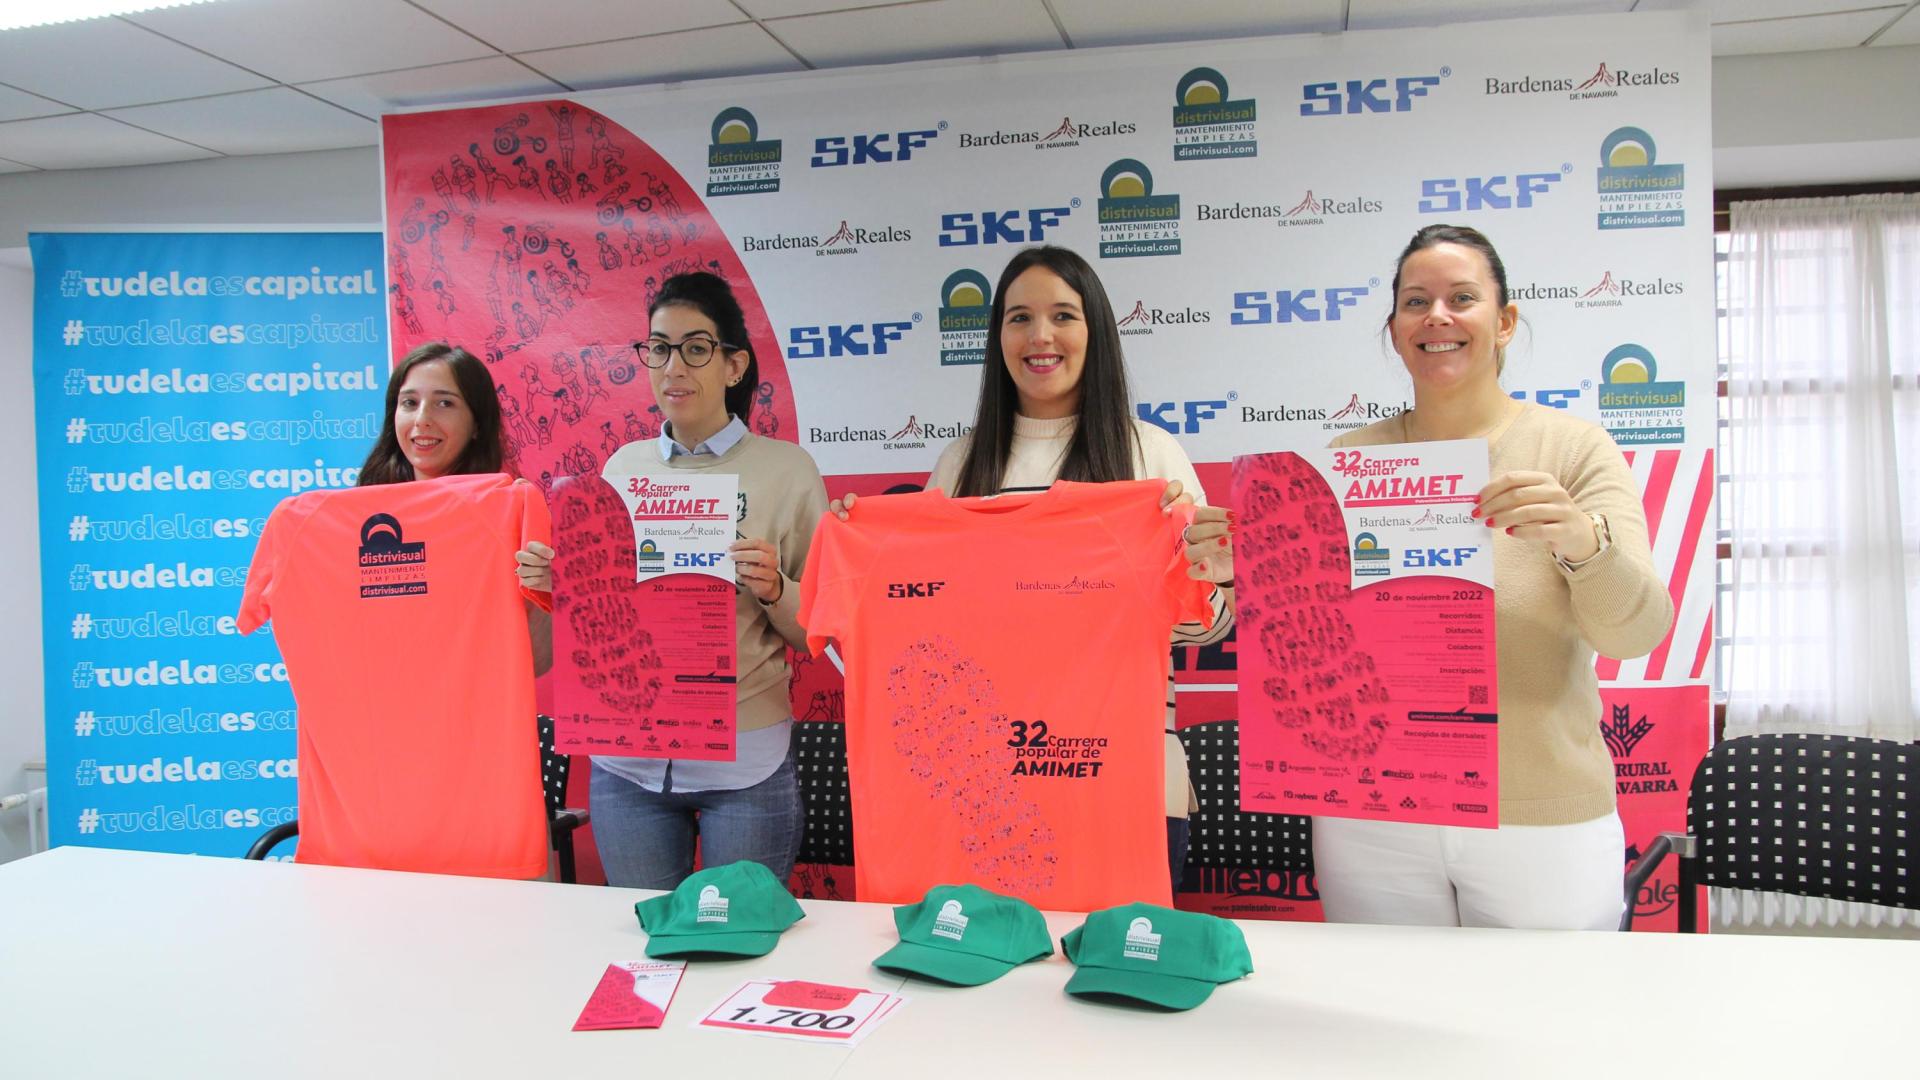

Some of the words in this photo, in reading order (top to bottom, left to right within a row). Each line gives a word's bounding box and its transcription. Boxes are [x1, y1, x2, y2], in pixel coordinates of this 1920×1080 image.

[1486, 76, 1573, 95] Bardenas
[1616, 68, 1680, 87] Reales
[1582, 90, 1618, 99] NAVARRA
[1176, 106, 1255, 125] distrivisual
[959, 130, 1040, 148] Bardenas
[1078, 121, 1137, 138] Reales
[1175, 123, 1255, 135] MANTENIMIENTO
[1047, 140, 1079, 149] NAVARRA
[1178, 144, 1255, 158] distrivisual.com
[710, 146, 781, 165] distrivisual
[709, 163, 780, 175] MANTENIMIENTO
[710, 181, 778, 194] distrivisual.com
[1600, 173, 1682, 190] distrivisual
[1599, 192, 1682, 203] MANTENIMIENTO
[1100, 201, 1179, 220] distrivisual
[1197, 203, 1282, 221] Bardenas
[1321, 197, 1383, 215] Reales
[1100, 221, 1179, 232] MANTENIMIENTO
[1289, 218, 1324, 226] NAVARRA
[1602, 213, 1682, 226] distrivisual.com
[743, 234, 819, 252] Bardenas
[855, 226, 911, 244] Reales
[826, 247, 858, 255] NAVARRA
[1103, 242, 1179, 255] distrivisual.com
[61, 267, 377, 300] #tudelaescapital
[1621, 278, 1684, 297] Reales
[1587, 299, 1622, 308] NAVARRA
[1151, 307, 1210, 325] Reales
[63, 314, 379, 349] #tudelaescapital
[1120, 328, 1153, 336] NAVARRA
[64, 363, 379, 397] #tudelaescapital
[1600, 388, 1683, 407] distrivisual
[1242, 404, 1326, 423] Bardenas
[1367, 402, 1415, 419] Real
[1600, 408, 1683, 419] MANTENIMIENTO
[66, 410, 380, 446] #tudelaescapital
[809, 426, 887, 443] Bardenas
[894, 441, 926, 449] NAVARRA
[1332, 450, 1363, 472] 32
[1364, 456, 1420, 470] Carrera
[1342, 465, 1397, 479] Popular
[627, 477, 650, 493] 32
[650, 483, 690, 492] Carrera
[1344, 474, 1464, 501] AMIMET
[634, 499, 720, 514] AMIMET
[1359, 515, 1411, 528] Bardenas
[644, 527, 680, 536] Bardenas
[698, 527, 725, 536] Reales
[361, 548, 424, 564] distrivisual
[362, 584, 426, 596] distrivisual.com
[888, 581, 945, 598] SKF
[1375, 591, 1391, 601] 20
[1452, 590, 1484, 601] 2022
[1007, 720, 1048, 748] 32
[1048, 735, 1108, 748] Carrera
[1016, 746, 1079, 760] popular
[1081, 746, 1101, 760] de
[1010, 761, 1103, 778] AMIMET
[729, 1007, 855, 1030] 1.700
